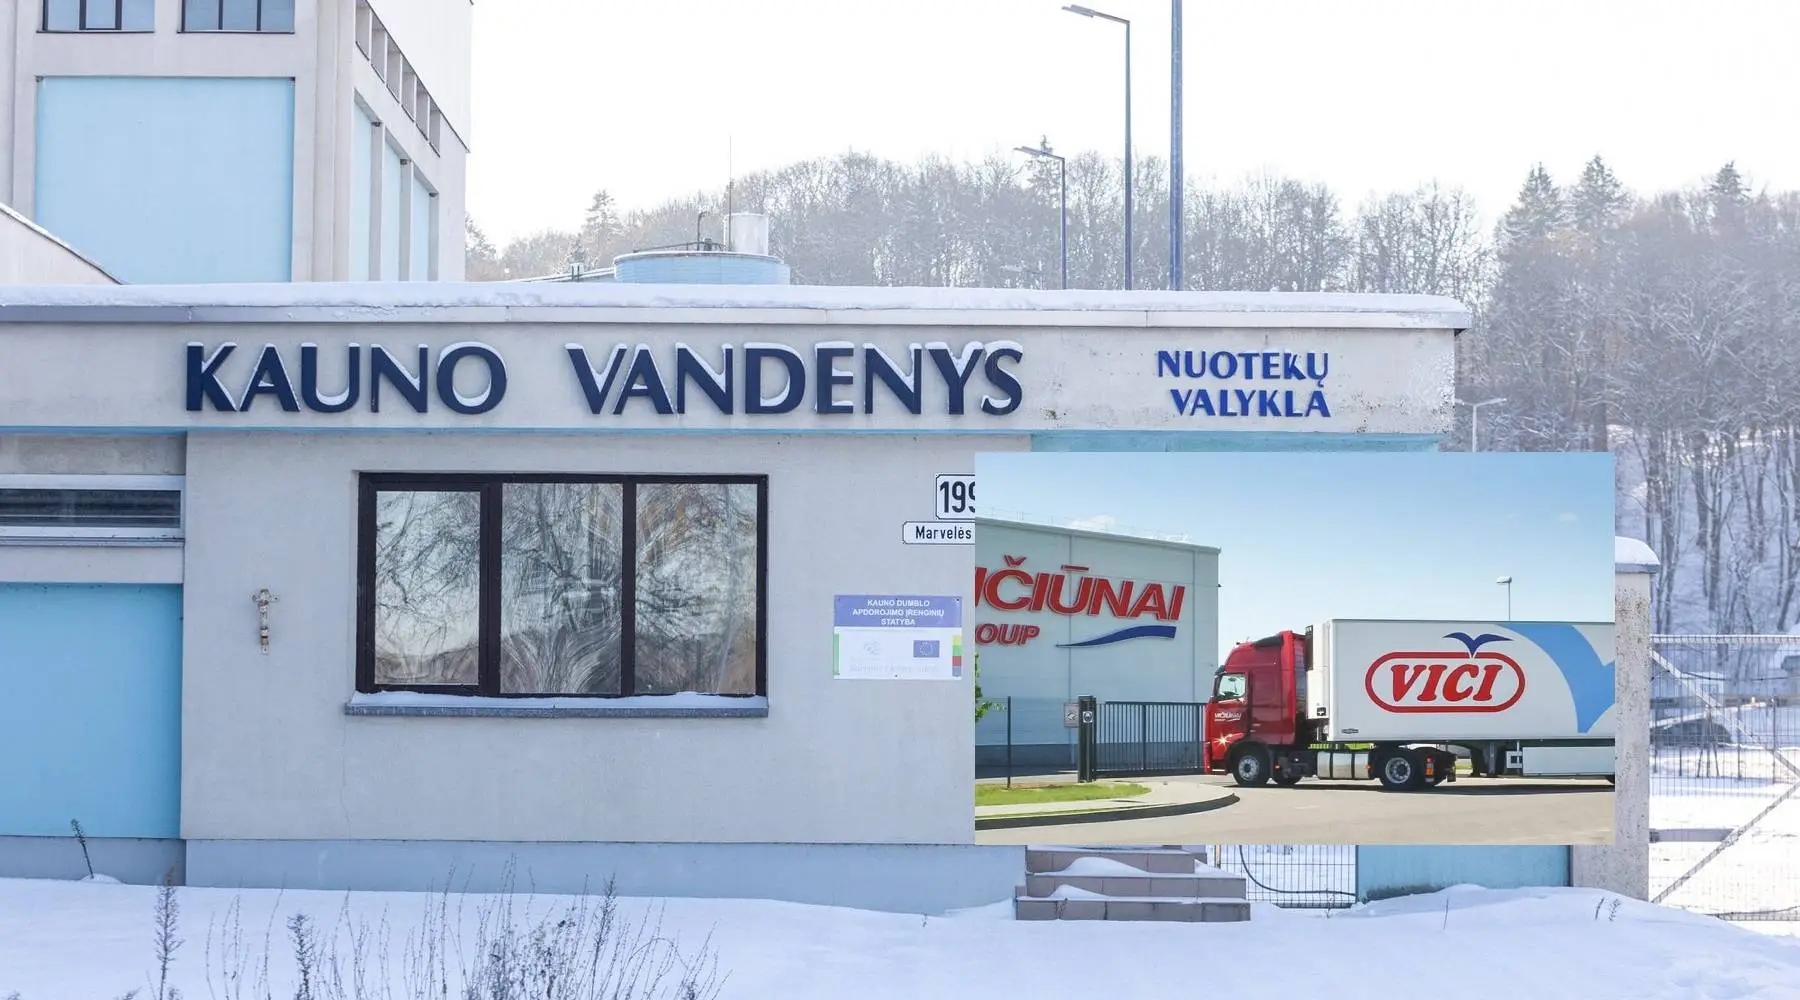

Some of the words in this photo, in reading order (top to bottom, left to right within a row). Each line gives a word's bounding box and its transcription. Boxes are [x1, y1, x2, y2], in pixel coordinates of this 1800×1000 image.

[1158, 350, 1329, 388] NUOTEKŲ
[186, 342, 508, 415] KAUNO
[565, 342, 1024, 415] VANDENYS
[1170, 388, 1332, 418] VALYKLA
[915, 525, 972, 541] Marvelės
[867, 599, 895, 607] KAUNO
[896, 599, 931, 607] DUMBLO
[852, 608, 904, 616] APDOROJIMO
[905, 608, 945, 617] ĮRENGINIŲ
[880, 618, 916, 626] STATYBA
